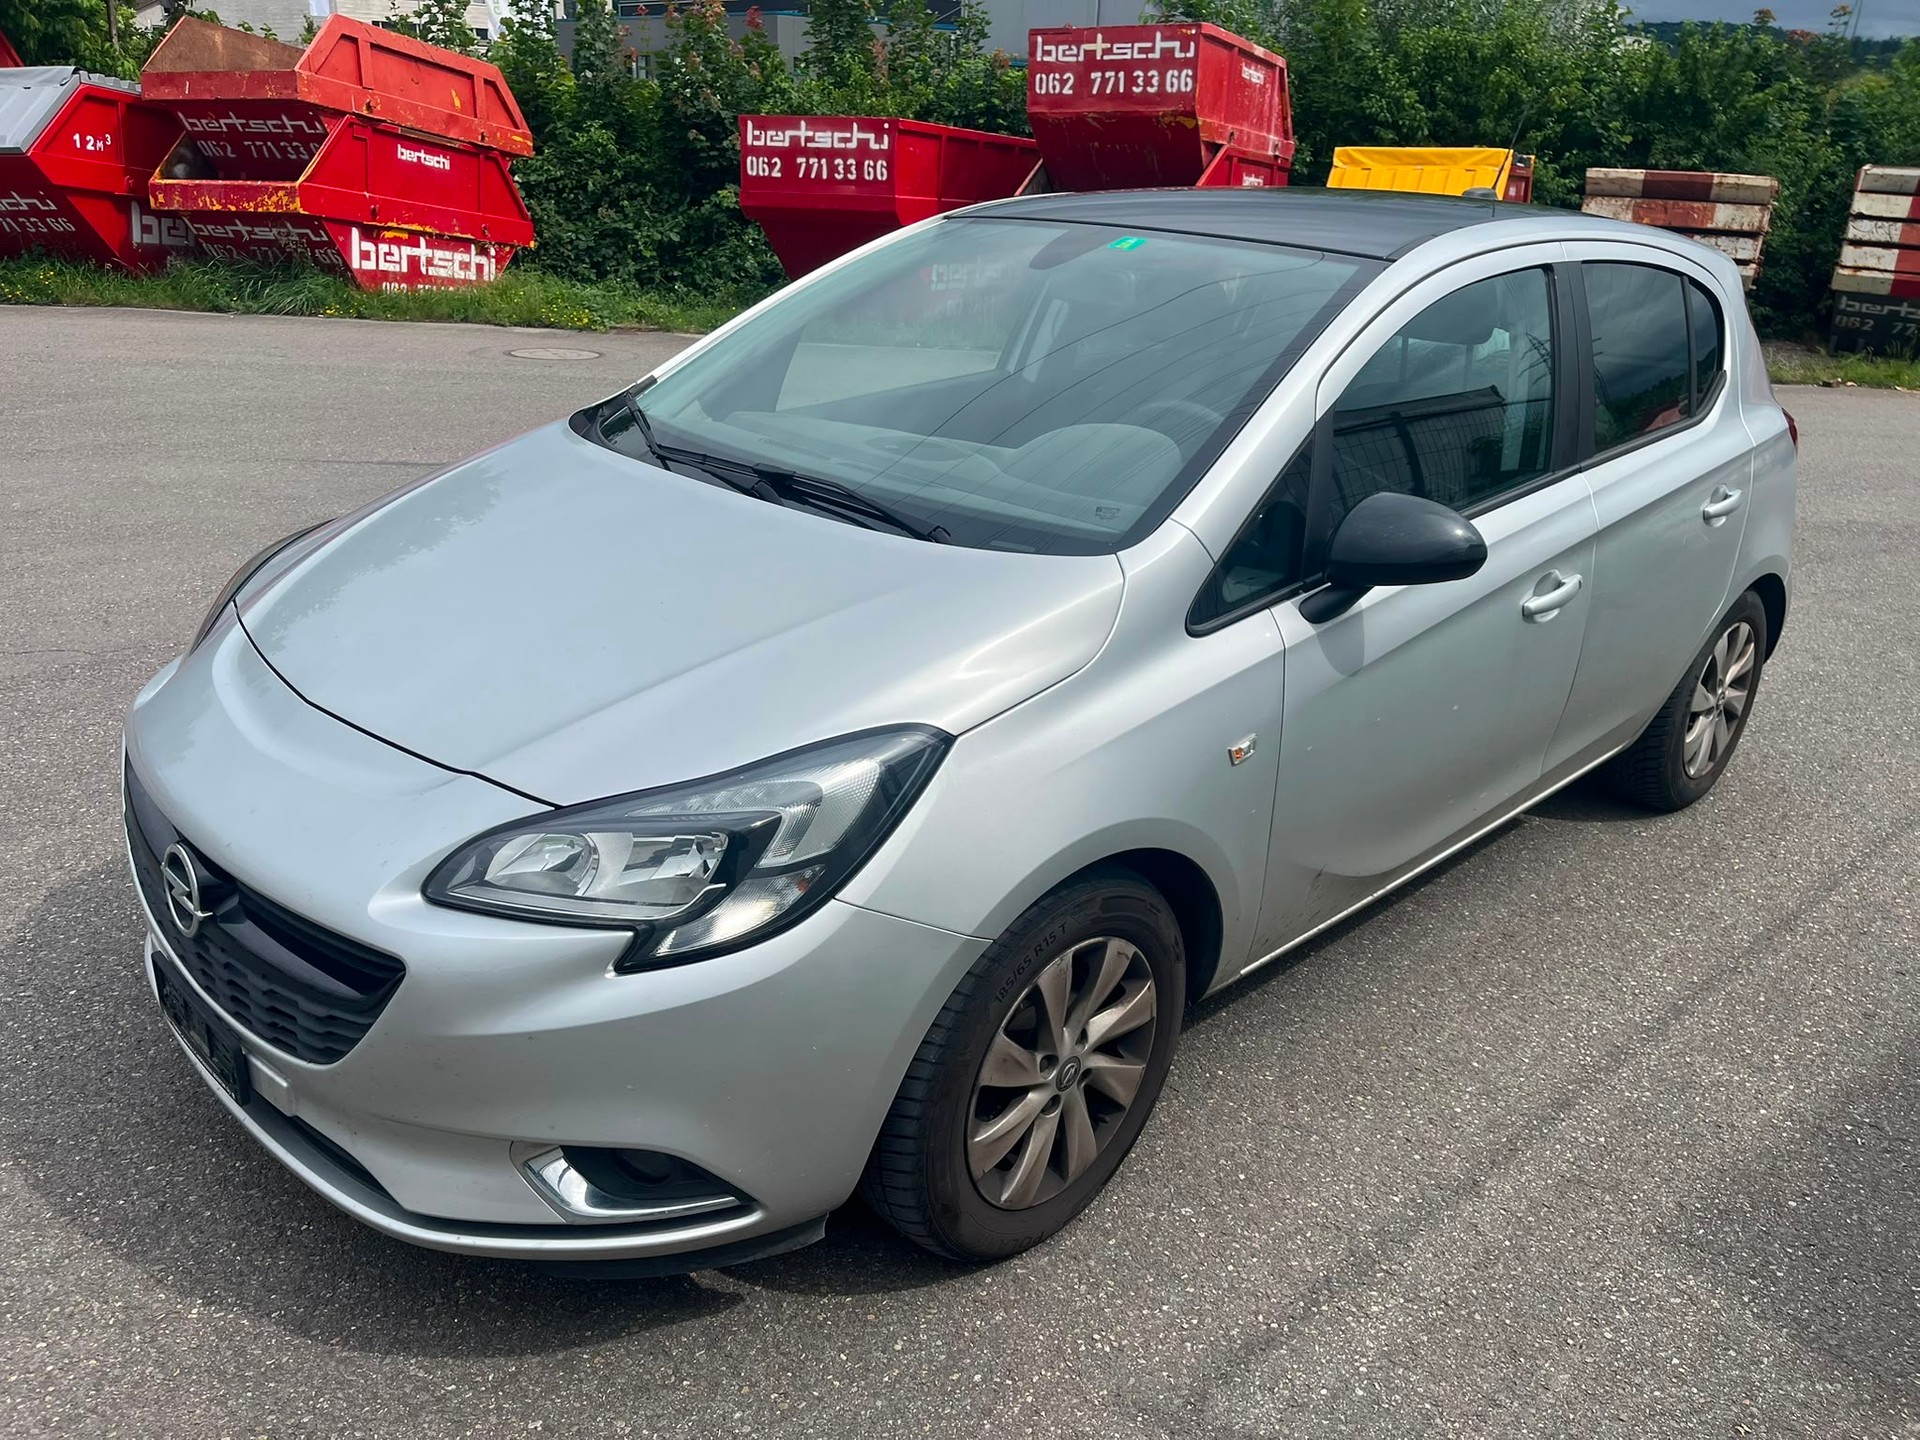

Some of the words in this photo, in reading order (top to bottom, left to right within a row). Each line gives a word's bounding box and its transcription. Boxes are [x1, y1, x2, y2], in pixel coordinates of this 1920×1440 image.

[1036, 28, 1197, 63] bertschi
[1035, 72, 1075, 95] 062
[1090, 70, 1125, 94] 771
[1132, 69, 1160, 94] 33
[1165, 68, 1194, 94] 66
[177, 111, 325, 134] bertschi
[746, 119, 890, 150] bertschi
[197, 140, 237, 158] 062
[243, 141, 282, 160] 771
[397, 143, 450, 171] bertschi
[746, 155, 782, 178] 062
[796, 156, 828, 180] 771
[834, 158, 857, 181] 33
[864, 159, 888, 181] 66
[131, 200, 195, 247] be
[351, 227, 496, 281] bertschi
[994, 954, 1032, 1003] 185/65
[1033, 930, 1057, 958] R15
[1058, 921, 1068, 934] T
